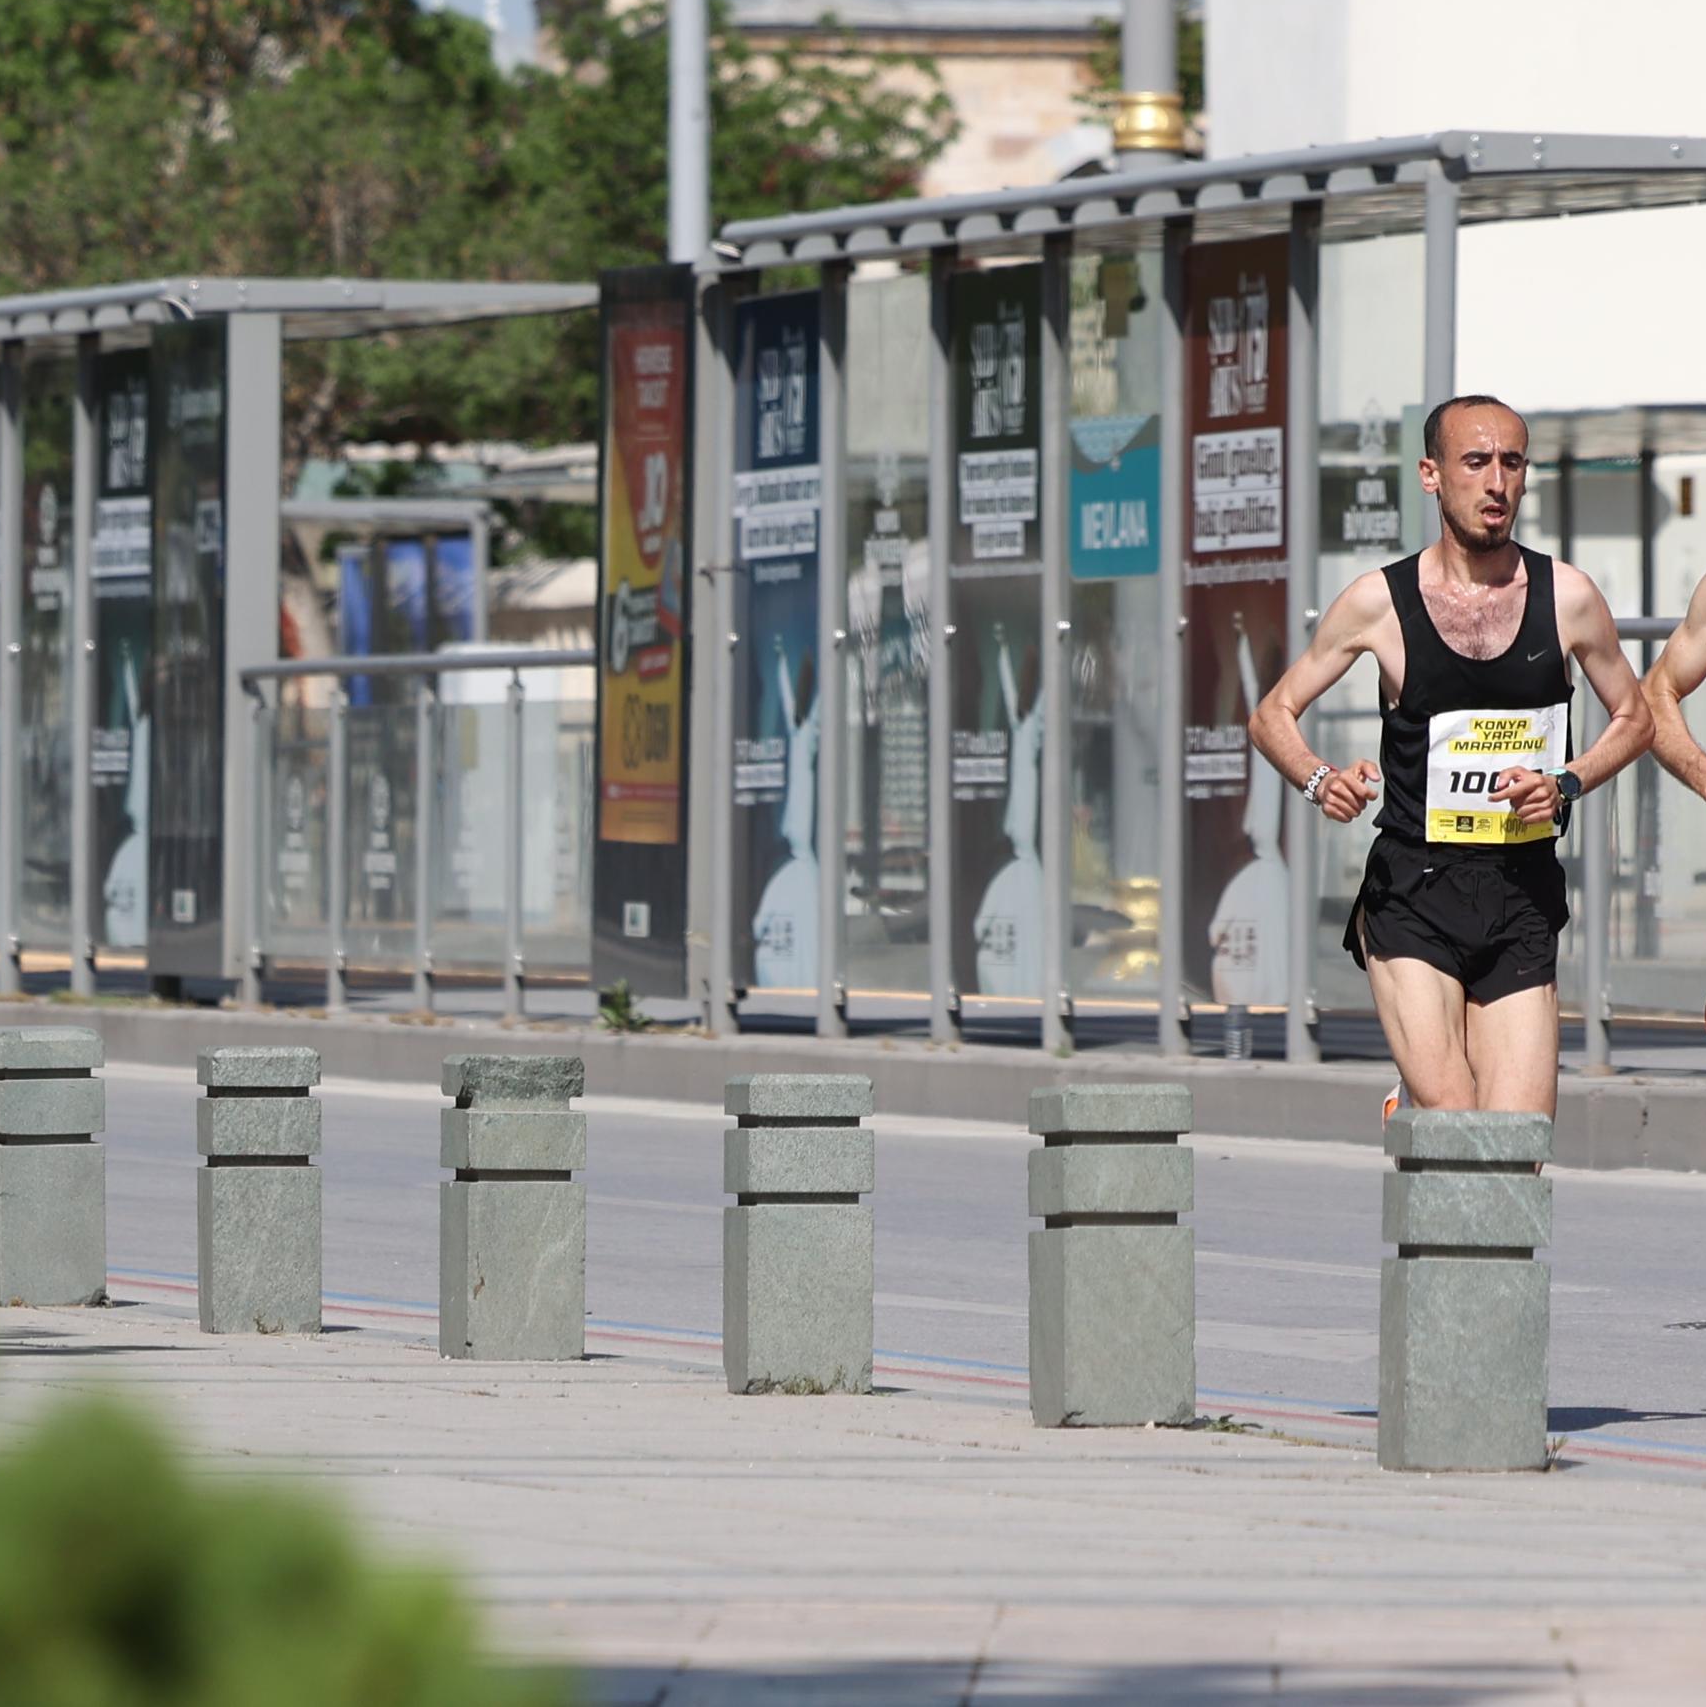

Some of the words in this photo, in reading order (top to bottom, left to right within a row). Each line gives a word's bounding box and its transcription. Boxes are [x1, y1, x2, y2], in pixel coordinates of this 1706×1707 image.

[1474, 720, 1528, 730] KONYA
[1482, 731, 1519, 740] YARI
[1454, 739, 1543, 751] MARATONU
